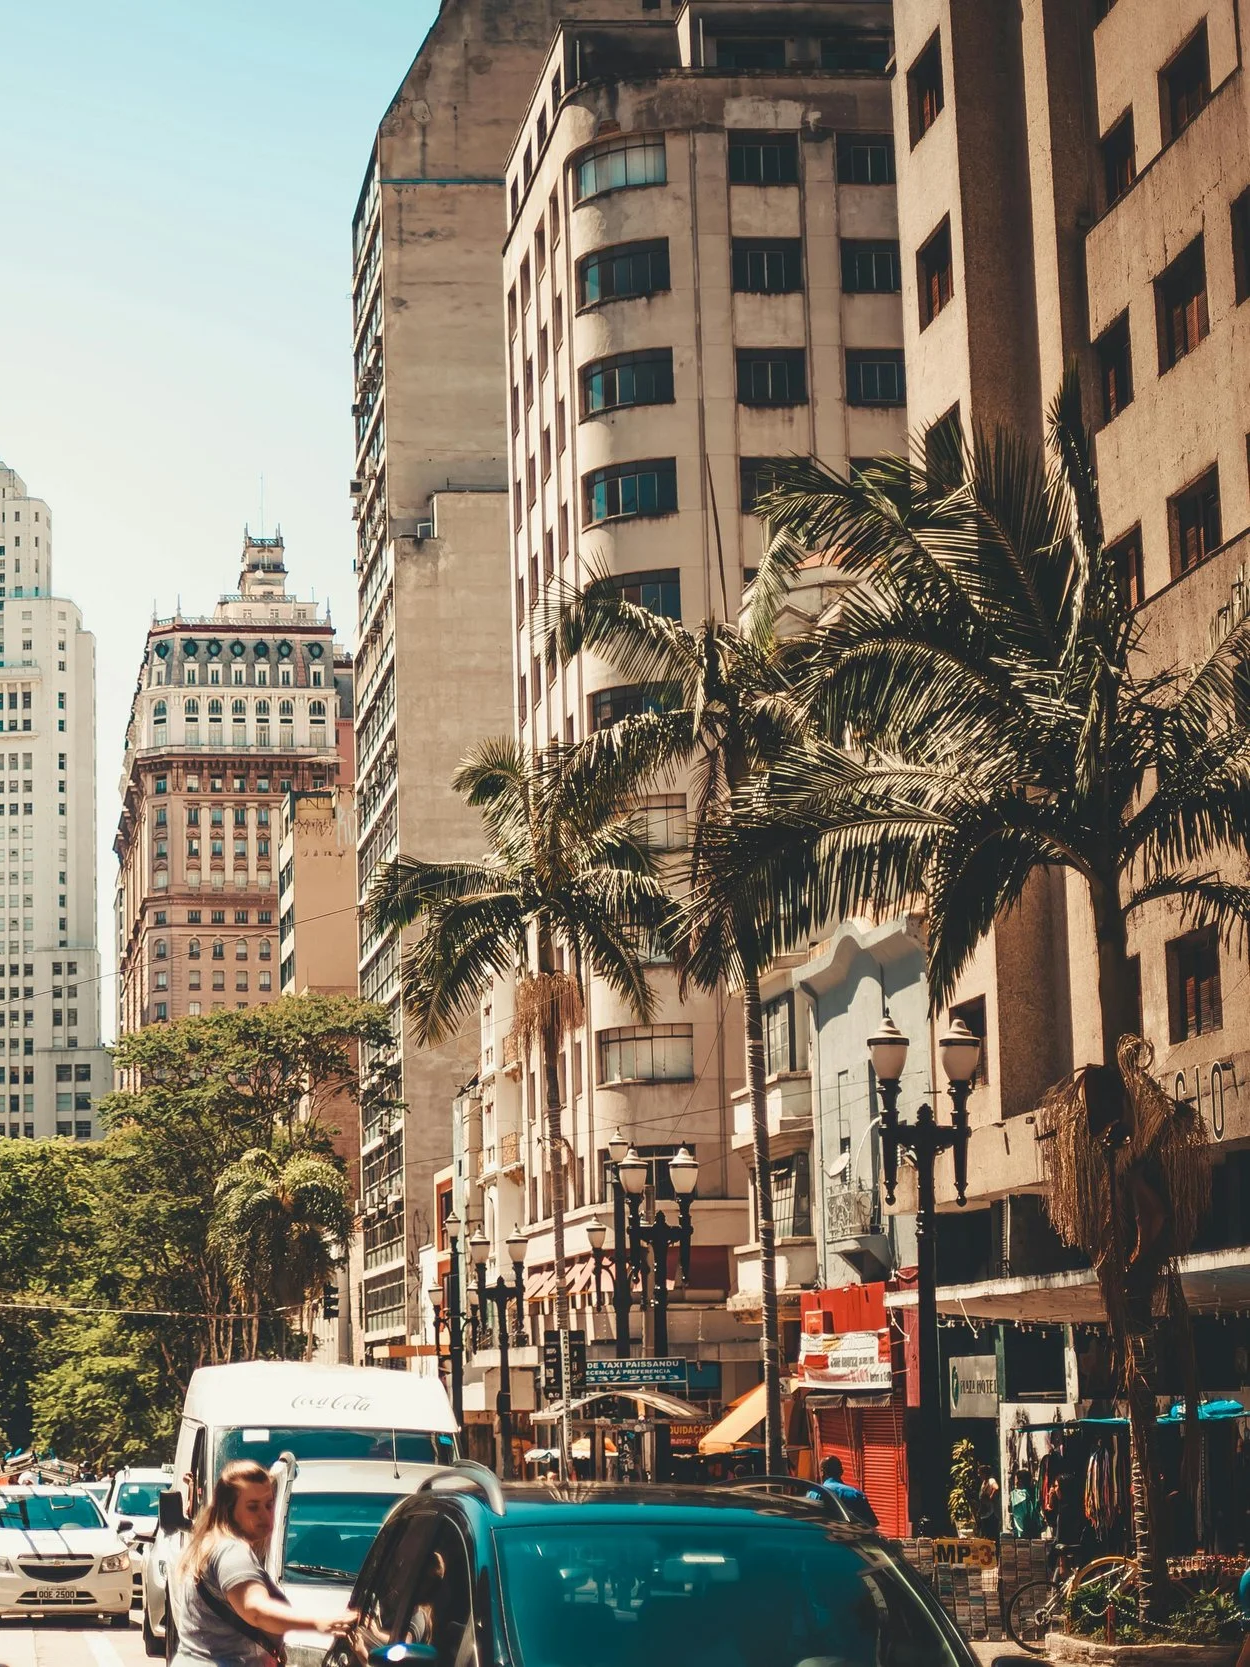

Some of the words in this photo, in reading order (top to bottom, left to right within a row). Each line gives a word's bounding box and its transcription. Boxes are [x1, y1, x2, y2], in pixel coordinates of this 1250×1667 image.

[586, 1362, 599, 1370] DE
[601, 1361, 623, 1369] TAXI
[625, 1360, 679, 1368] PAISSANDU
[55, 1590, 75, 1599] 2500
